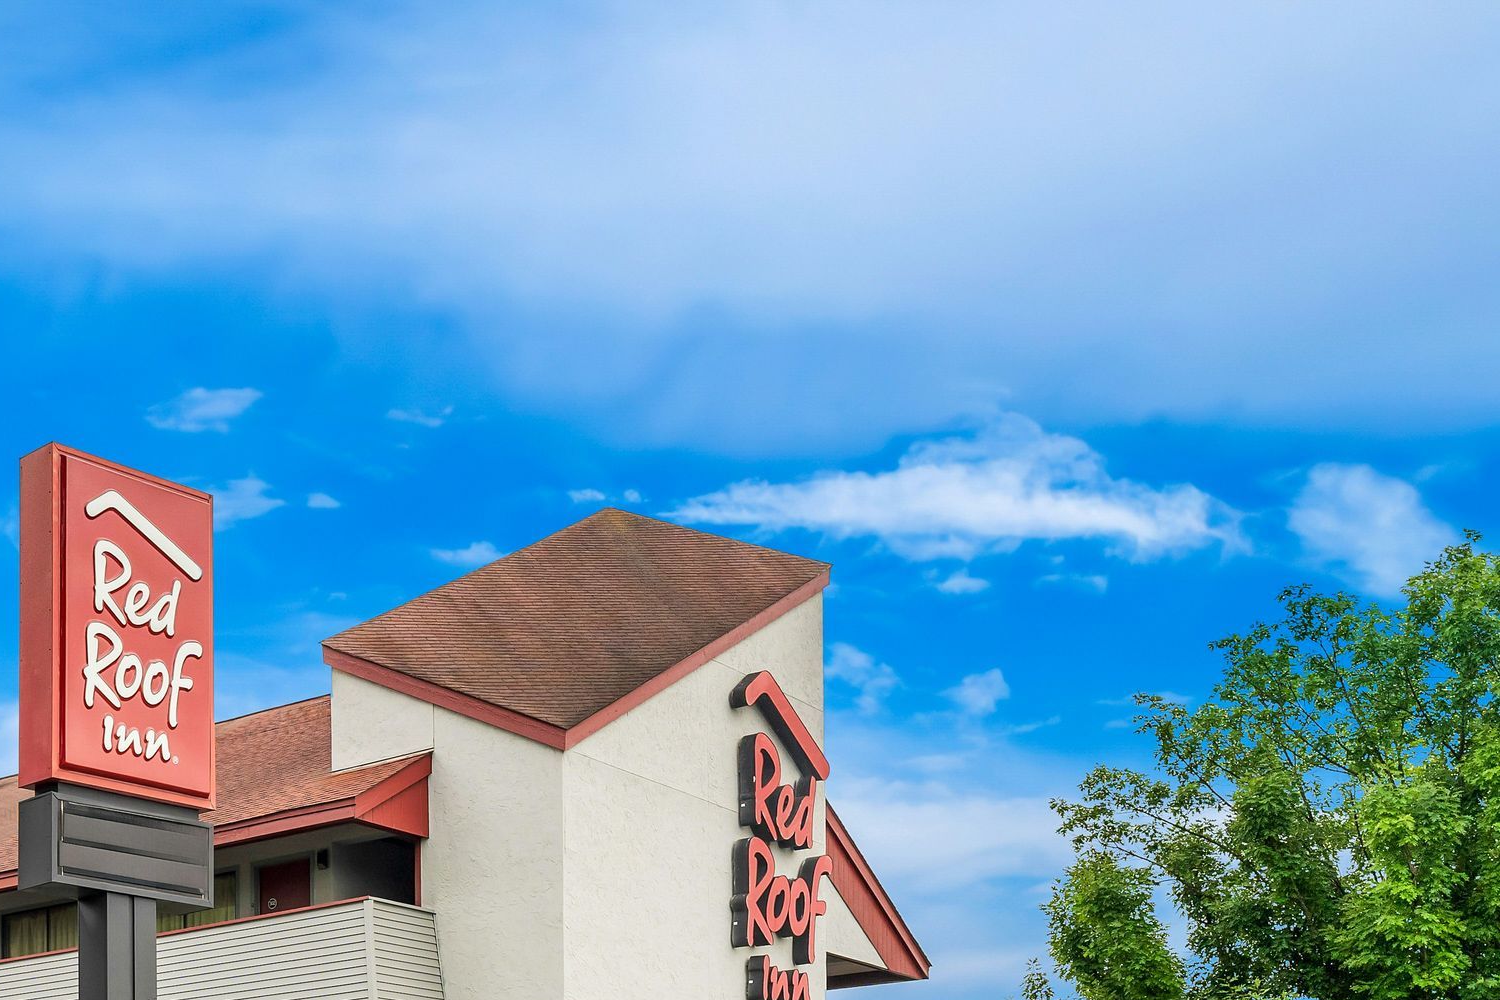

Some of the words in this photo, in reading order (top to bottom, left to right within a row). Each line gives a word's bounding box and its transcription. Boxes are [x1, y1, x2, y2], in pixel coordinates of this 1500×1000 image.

[94, 538, 182, 637] Red
[83, 621, 203, 728] Roof
[103, 715, 171, 762] Inn
[754, 732, 816, 849] Red
[746, 836, 834, 964] Roof
